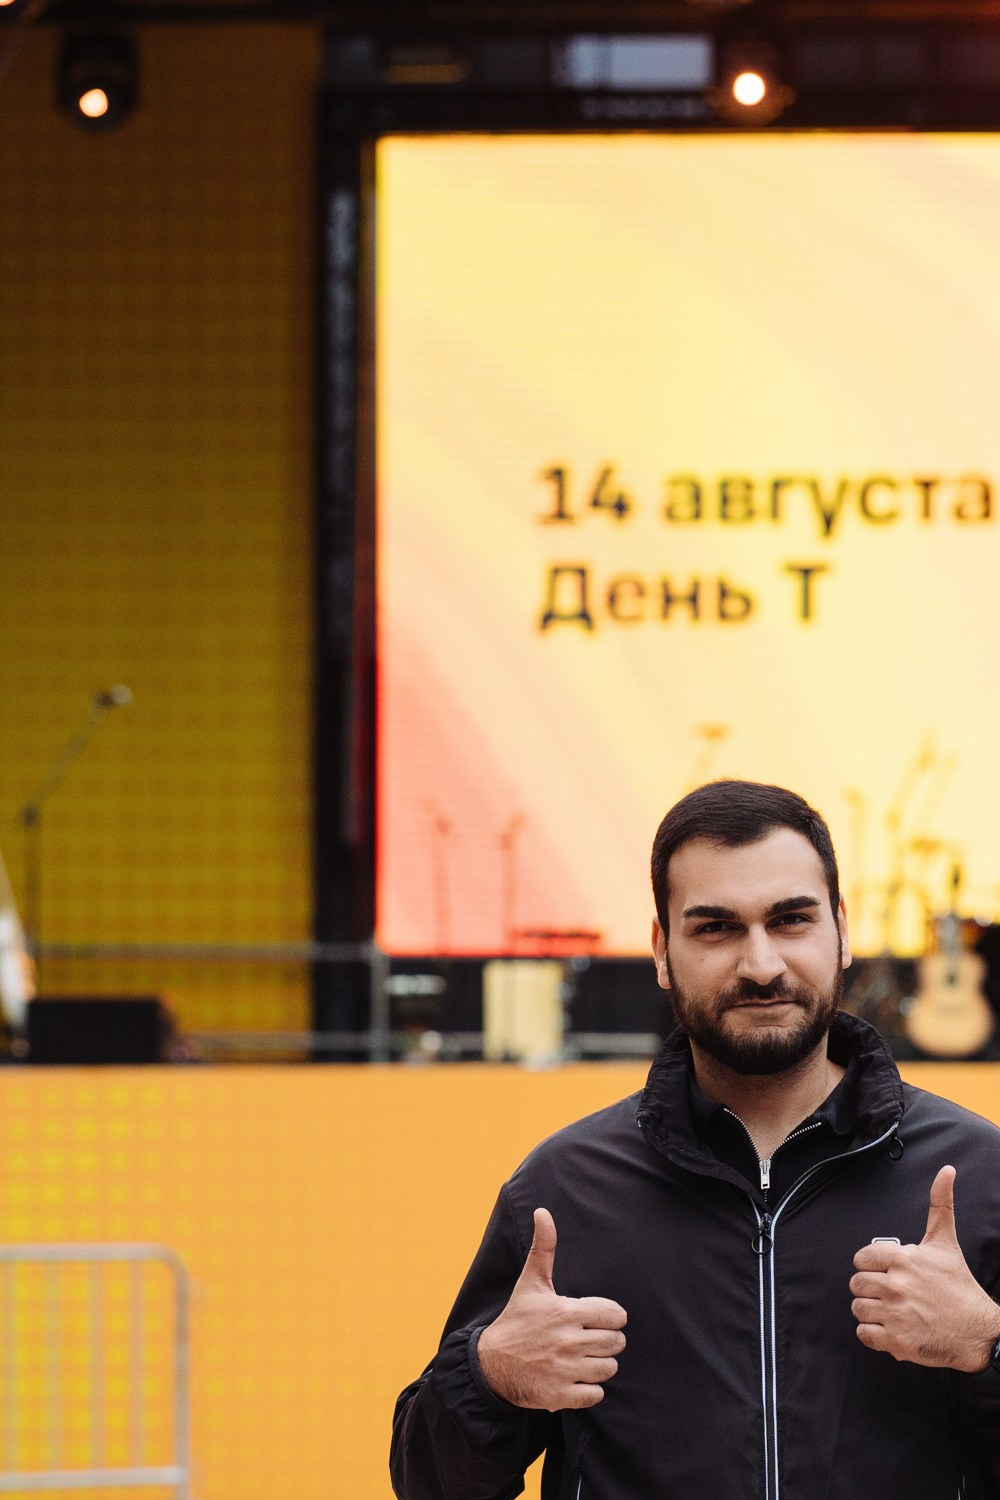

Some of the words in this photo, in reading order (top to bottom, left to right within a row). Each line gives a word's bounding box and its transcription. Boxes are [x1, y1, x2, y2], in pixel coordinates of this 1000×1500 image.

[539, 463, 634, 526] 14
[662, 472, 995, 541] августа
[538, 563, 756, 634] День
[781, 561, 829, 624] Т
